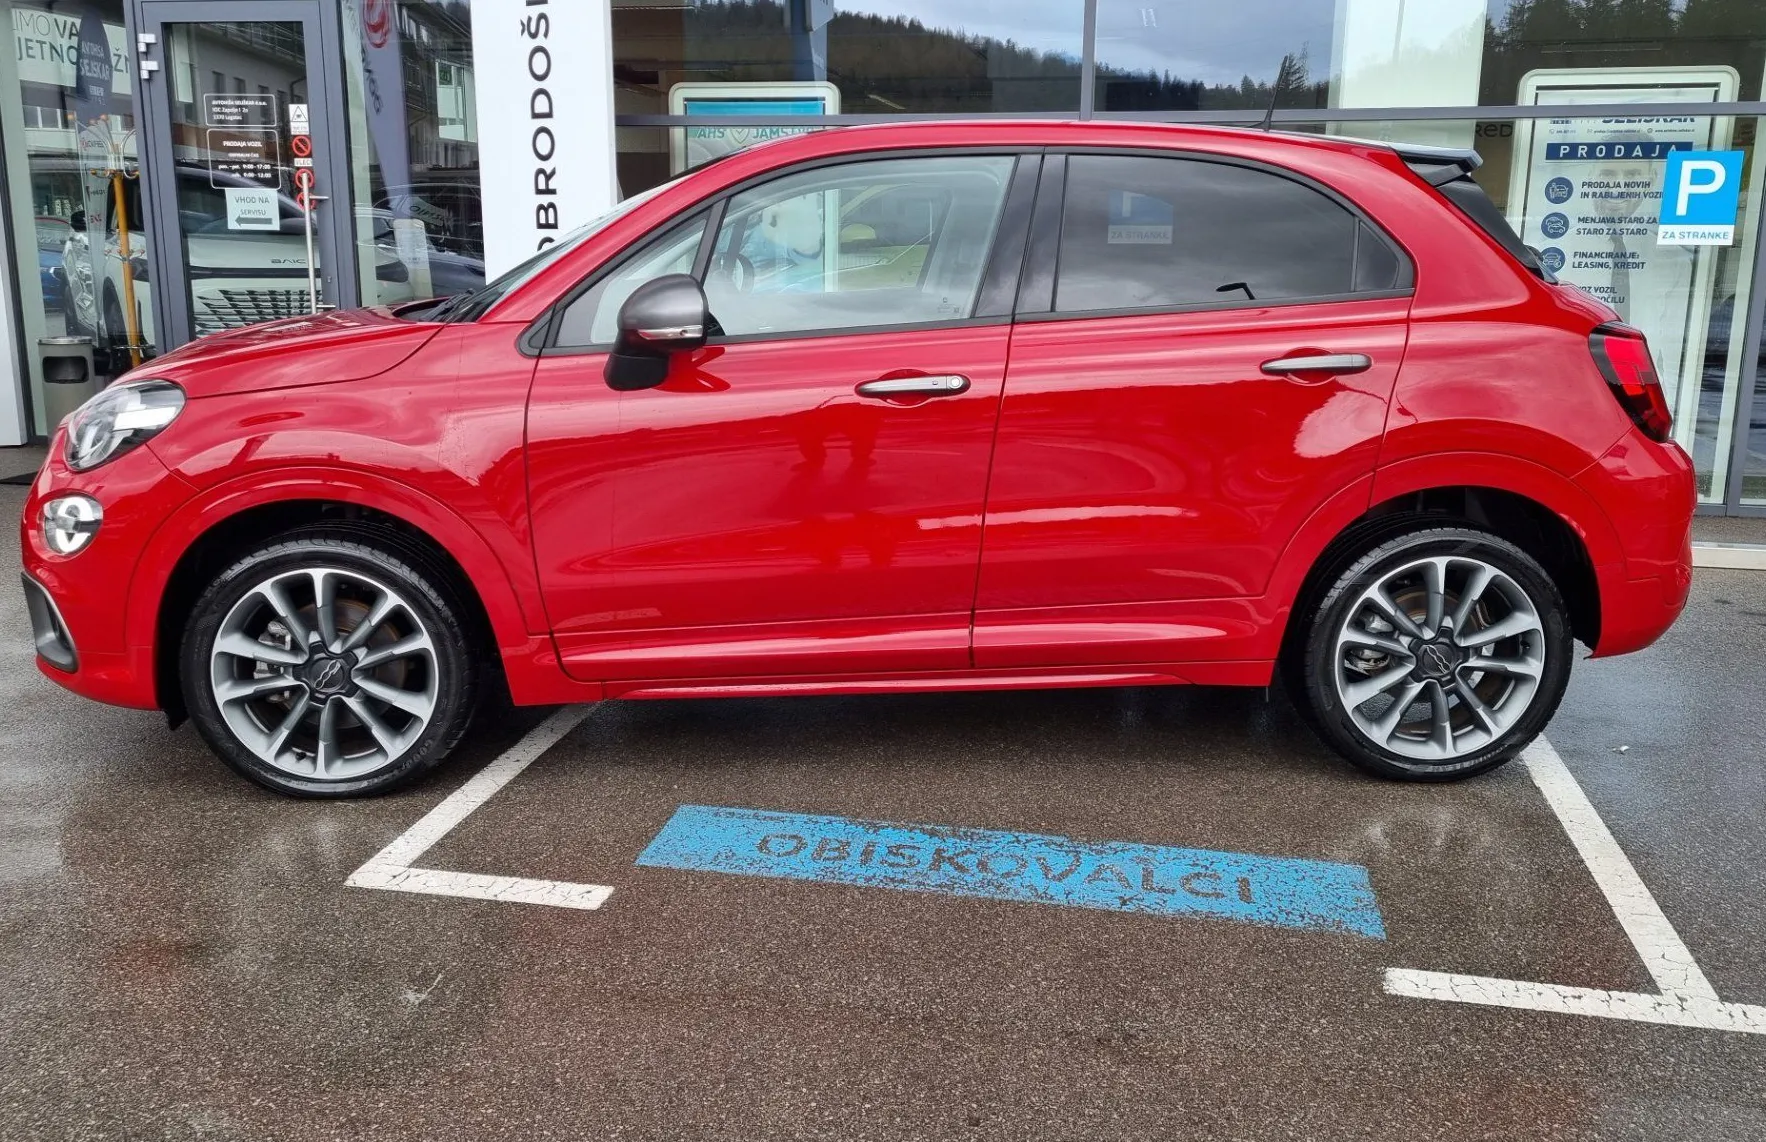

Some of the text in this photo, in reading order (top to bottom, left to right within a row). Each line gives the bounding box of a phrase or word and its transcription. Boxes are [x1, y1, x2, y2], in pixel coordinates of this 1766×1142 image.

[1581, 181, 1651, 189] PRODAJA NOVIH
[1676, 160, 1726, 216] P
[1580, 191, 1590, 199] IN
[1591, 191, 1641, 199] RABLJENIH
[234, 196, 256, 204] VHOD
[1577, 216, 1658, 224] MENJAVA STARO ZA
[1576, 228, 1604, 236] STARO
[1619, 228, 1648, 236] STARO
[1662, 231, 1729, 239] ZA STRANKE
[1573, 251, 1640, 259] FINANCIRANJE:
[1572, 262, 1612, 270] LEASING,
[1593, 286, 1618, 294] VOZIL
[756, 832, 1254, 904] OBISKOVALCI
